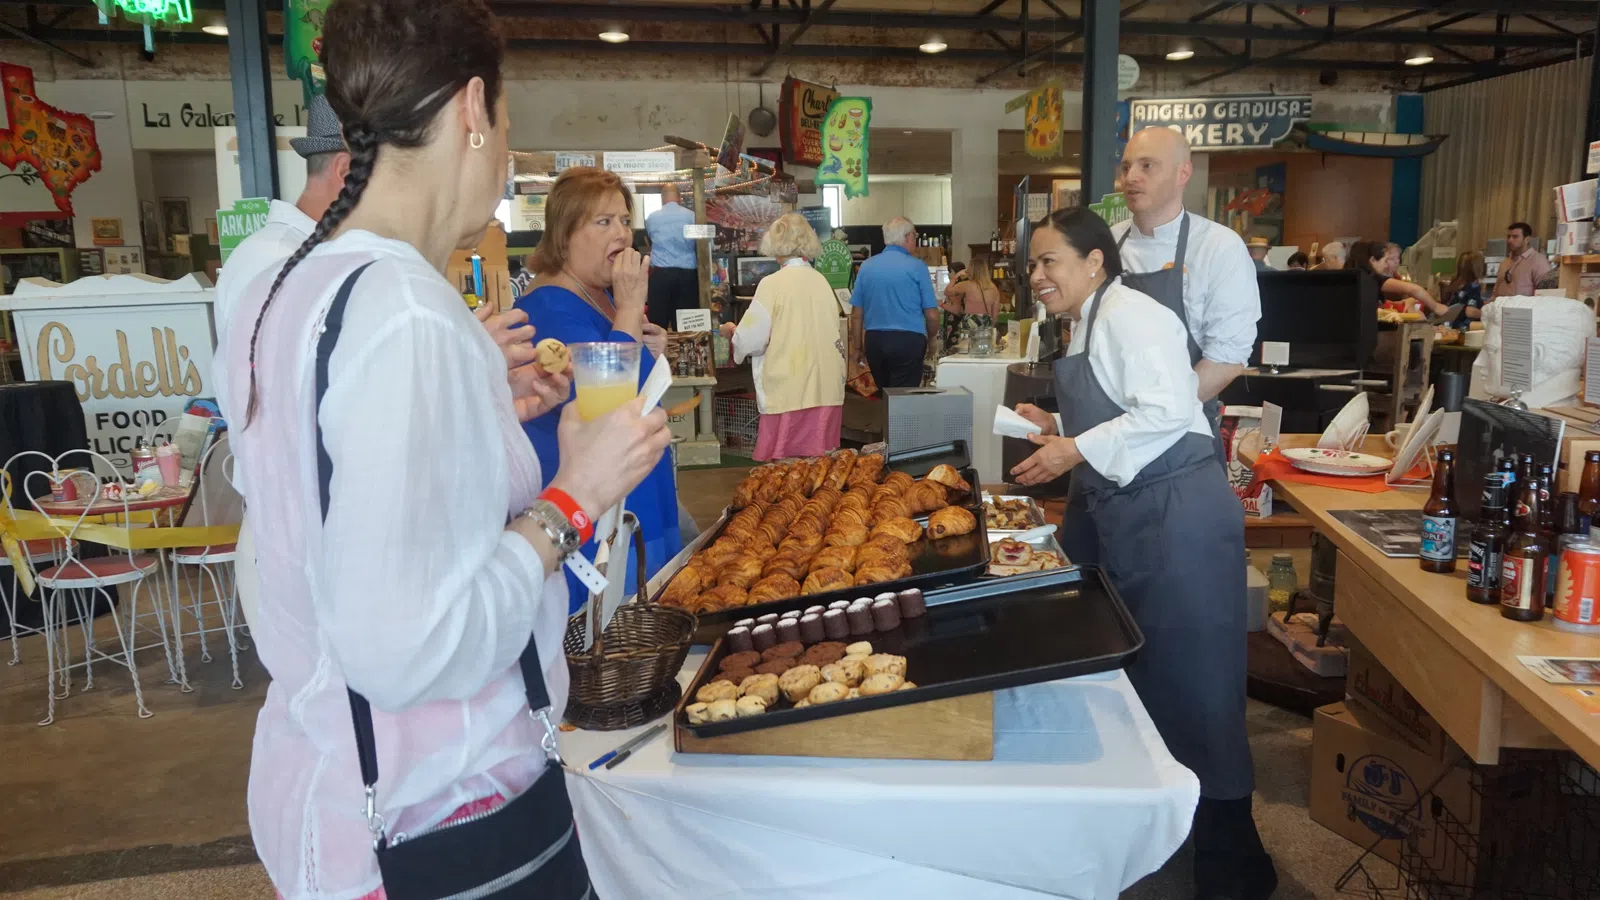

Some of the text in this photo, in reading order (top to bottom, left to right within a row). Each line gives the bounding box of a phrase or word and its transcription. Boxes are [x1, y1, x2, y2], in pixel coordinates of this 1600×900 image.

[142, 102, 171, 128] La
[1135, 101, 1301, 121] ANGELO GENDUSA
[1160, 122, 1269, 145] KERY
[623, 161, 646, 169] more
[37, 321, 202, 402] Cordell's
[95, 409, 168, 431] FOOD
